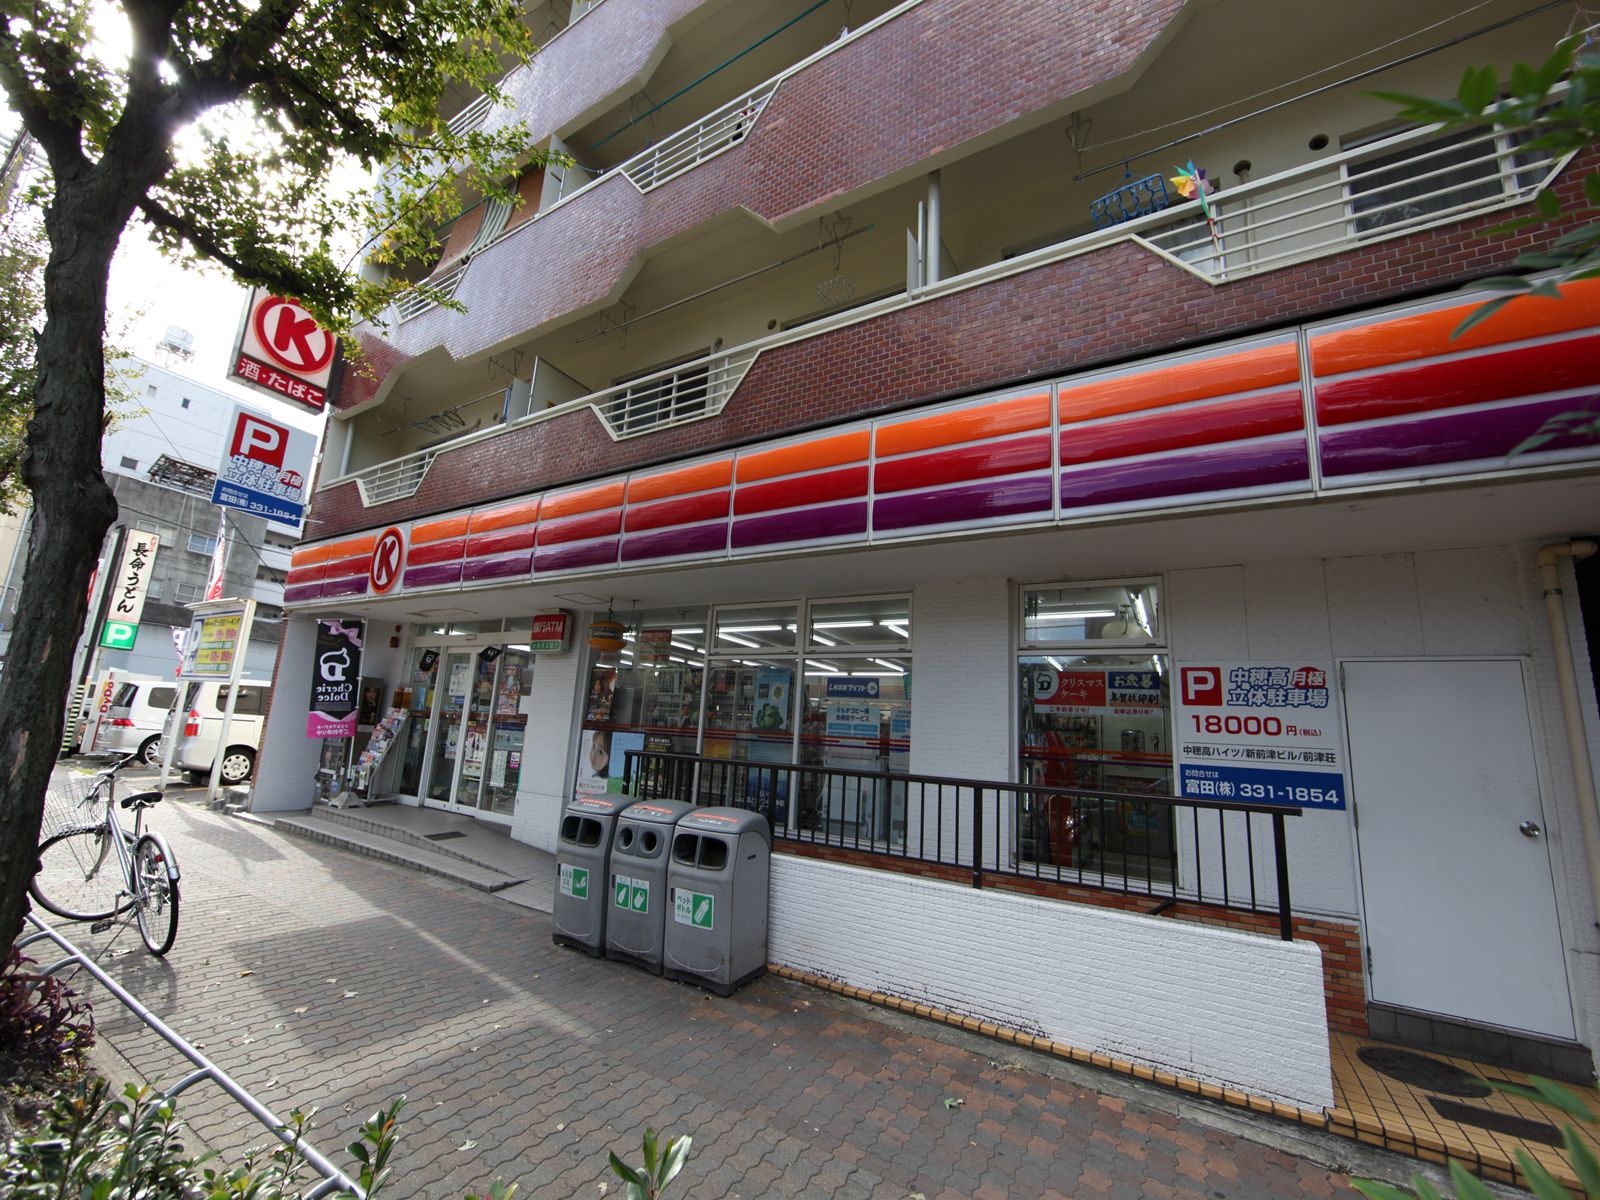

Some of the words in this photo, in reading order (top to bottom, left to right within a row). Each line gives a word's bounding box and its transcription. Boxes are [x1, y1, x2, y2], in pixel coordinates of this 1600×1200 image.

[239, 357, 324, 407] 酒・たばこ
[239, 419, 280, 455] P
[231, 454, 280, 480] 中穂高
[223, 467, 302, 501] 立体駐車場
[249, 502, 297, 521] 331-1854
[116, 542, 149, 614] 長命うどん
[106, 623, 133, 644] P
[1060, 678, 1104, 688] クリスマス
[1186, 670, 1215, 700] P
[1230, 667, 1290, 688] 中穂高
[1291, 670, 1326, 688] 月極
[99, 681, 115, 714] DyDo
[1060, 690, 1088, 699] ケーキ
[1227, 687, 1329, 708] 立体駐車場
[1183, 745, 1337, 764] 中穂高ハイツ/新前津ビル/前津荘
[1184, 769, 1219, 778] お問合せは
[1185, 779, 1235, 797] 富田(株)
[1239, 783, 1339, 804] 331-1854
